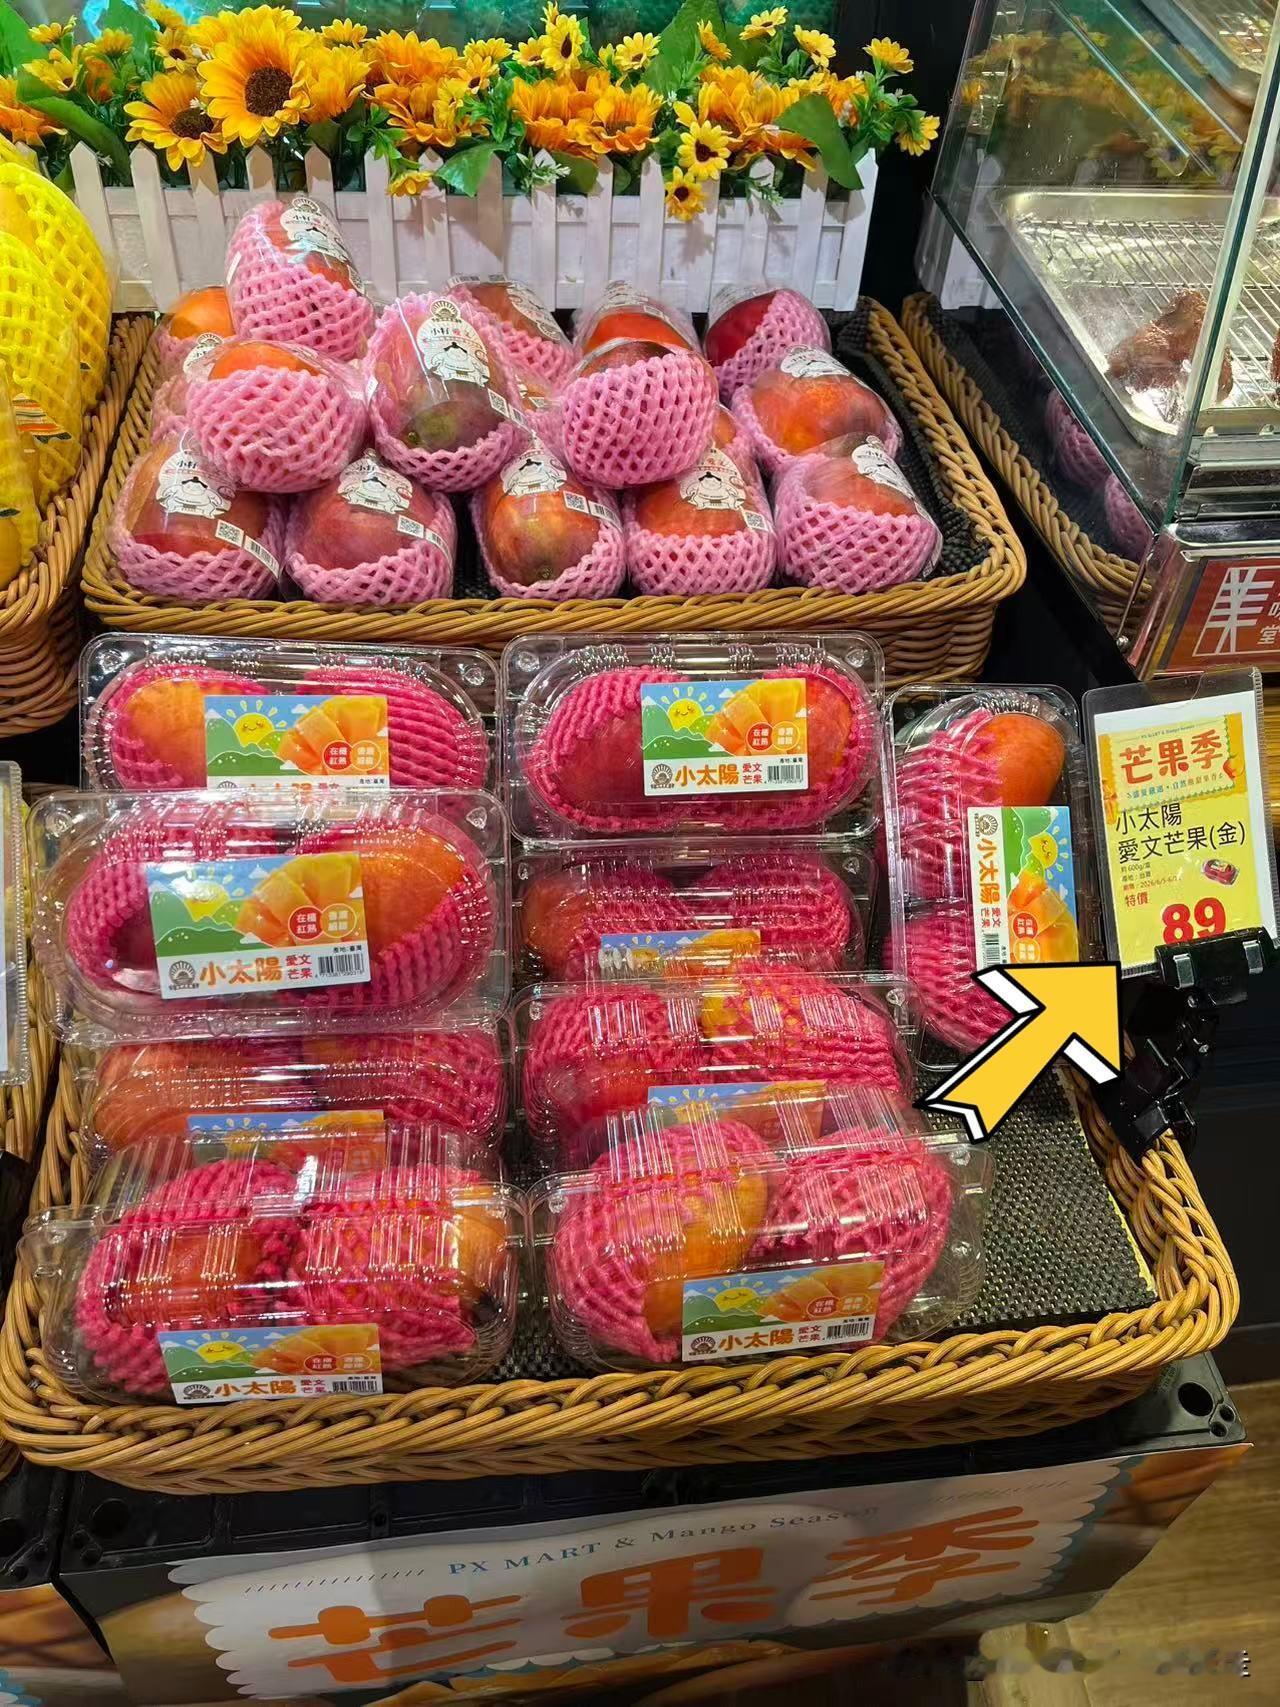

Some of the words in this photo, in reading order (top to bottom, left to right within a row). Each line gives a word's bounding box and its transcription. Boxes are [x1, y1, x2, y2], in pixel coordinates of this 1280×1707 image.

[743, 763, 763, 773] 愛文
[1119, 729, 1223, 784] 芒果季
[675, 763, 739, 787] 小太陽
[743, 775, 763, 784] 芒果
[1116, 803, 1183, 836] 小太陽
[1117, 820, 1246, 865] 愛文芒果(金)
[977, 838, 1001, 904] 小太陽
[1125, 891, 1148, 907] 特價
[1162, 896, 1227, 946] 89
[200, 956, 283, 986] 小太陽
[285, 953, 312, 966] 愛文
[287, 967, 313, 980] 芒果
[718, 1328, 794, 1351] 小太陽
[214, 1379, 297, 1396] 小太陽
[447, 1559, 490, 1576] PX
[504, 1540, 601, 1570] MART
[614, 1536, 635, 1549] &
[651, 1521, 757, 1543] Mango
[769, 1505, 879, 1530] Season
[267, 1505, 1036, 1682] 芒果季
